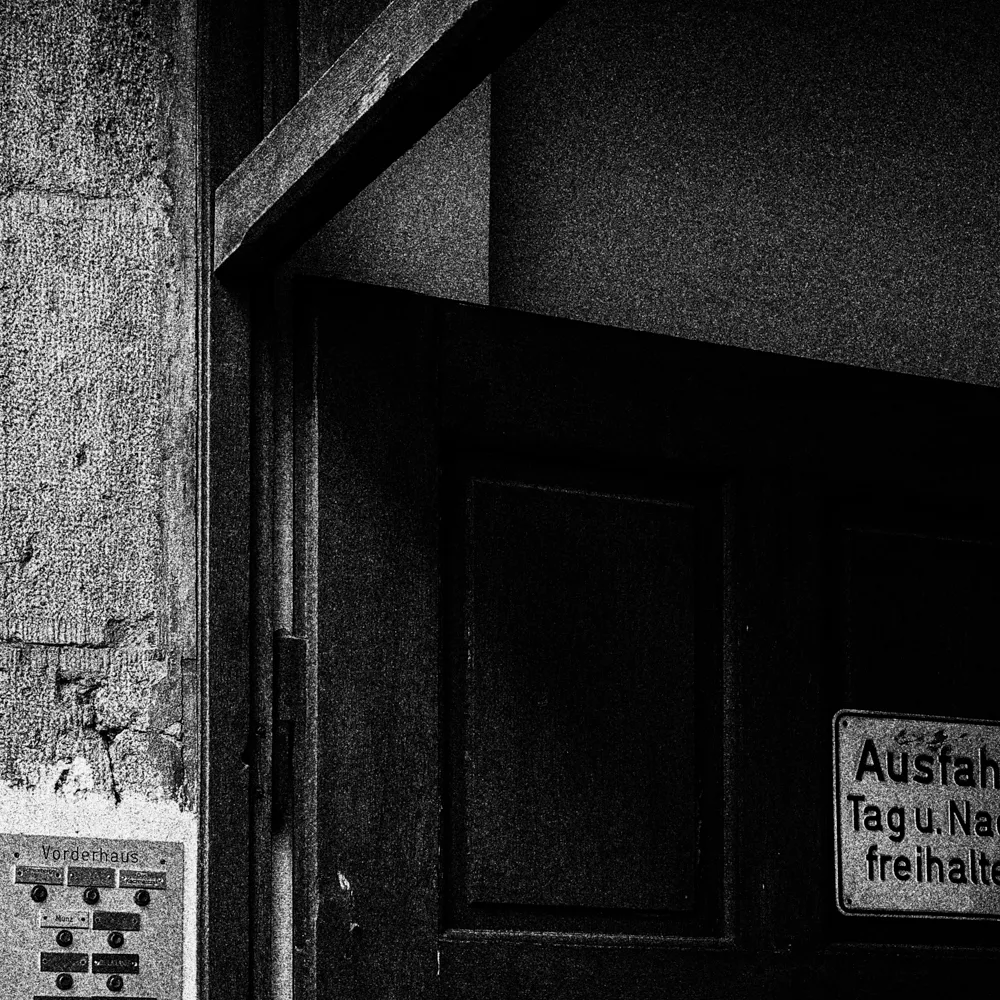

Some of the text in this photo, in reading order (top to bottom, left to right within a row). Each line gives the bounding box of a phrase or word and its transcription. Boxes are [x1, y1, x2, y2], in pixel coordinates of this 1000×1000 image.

[846, 794, 906, 843] Tag
[949, 800, 1000, 837] Na
[42, 845, 139, 864] Vorderhaus
